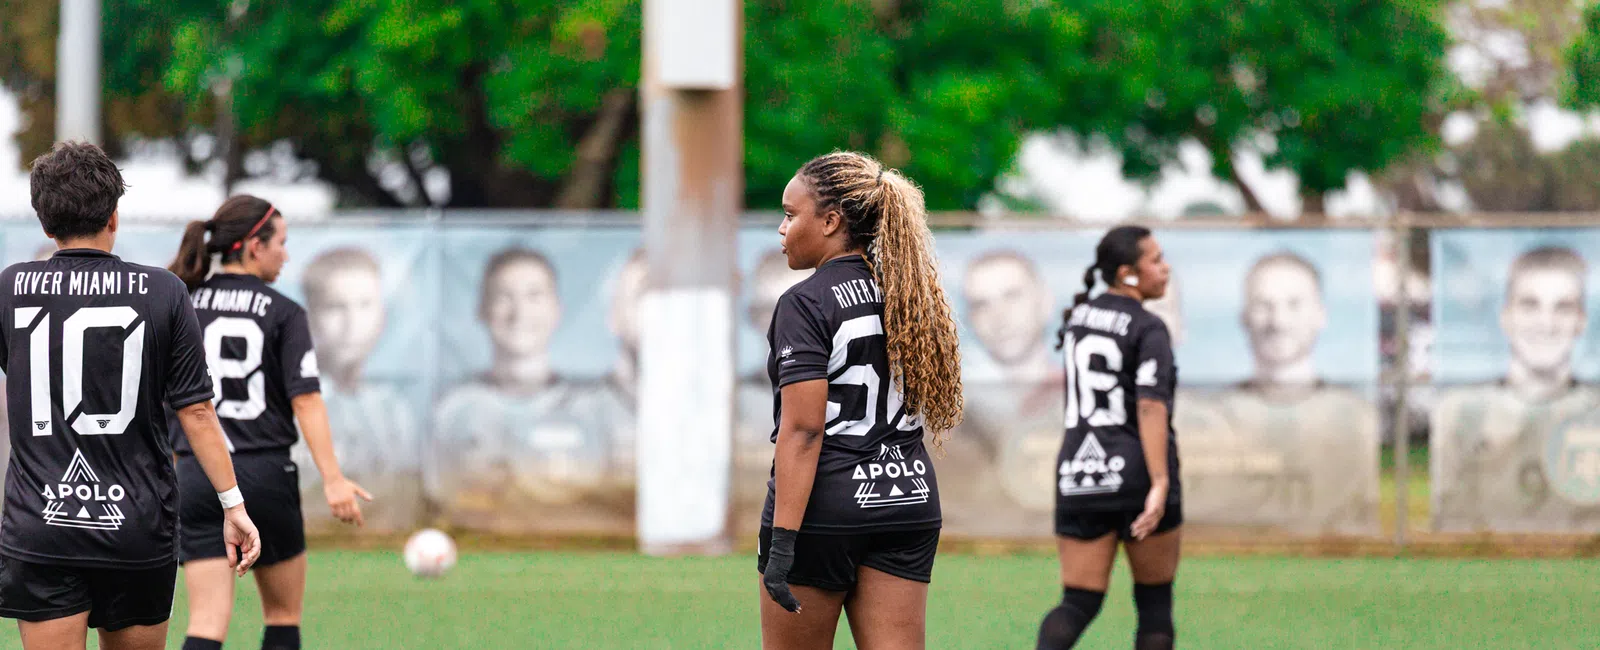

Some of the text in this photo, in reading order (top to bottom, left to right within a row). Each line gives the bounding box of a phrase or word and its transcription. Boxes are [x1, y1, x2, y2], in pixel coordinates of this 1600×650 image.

[14, 271, 148, 295] RIVER MIAMI FC
[831, 279, 874, 308] RIVER
[251, 292, 272, 317] FC
[14, 306, 145, 436] 10
[204, 317, 266, 420] 8
[1063, 331, 1126, 428] 16
[851, 458, 926, 480] APOLO
[41, 483, 126, 502] APOLO
